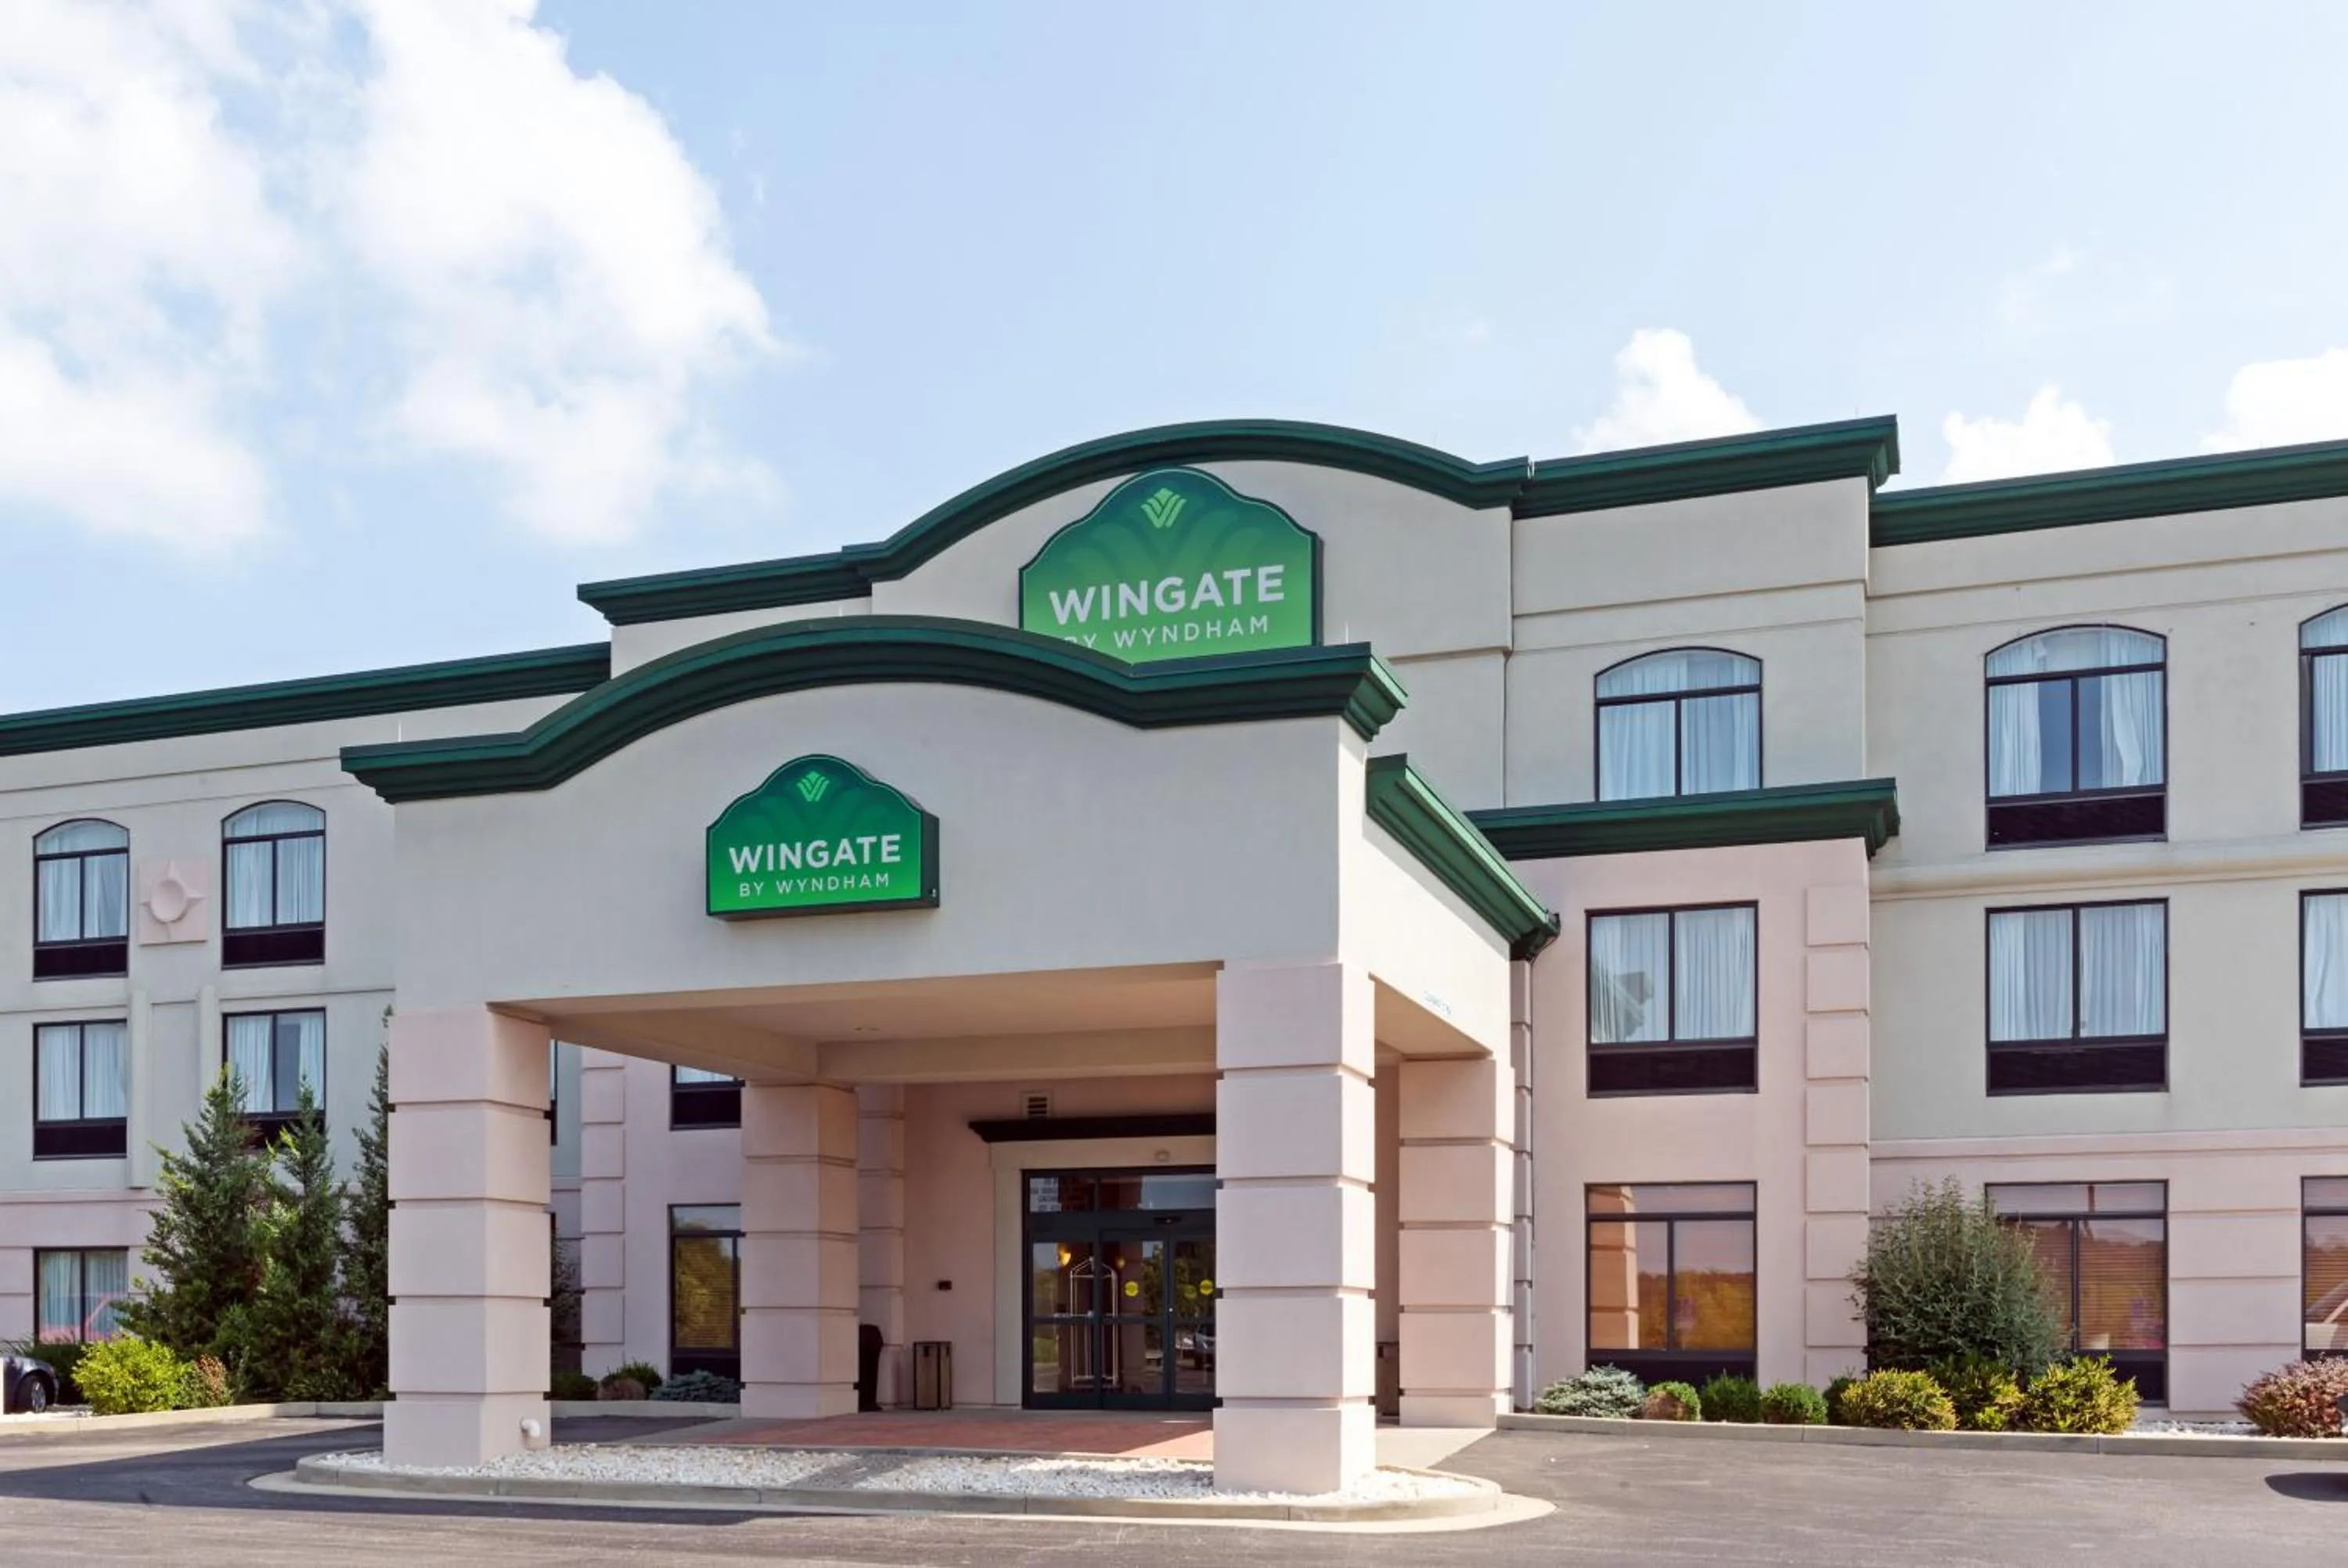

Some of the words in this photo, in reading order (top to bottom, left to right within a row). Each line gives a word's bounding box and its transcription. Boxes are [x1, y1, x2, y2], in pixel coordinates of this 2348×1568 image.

[1049, 564, 1285, 625] WINGATE
[1115, 615, 1269, 649] WYNDHAM
[729, 834, 901, 874] WINGATE
[739, 882, 764, 897] BY
[776, 872, 889, 894] WYNDHAM
